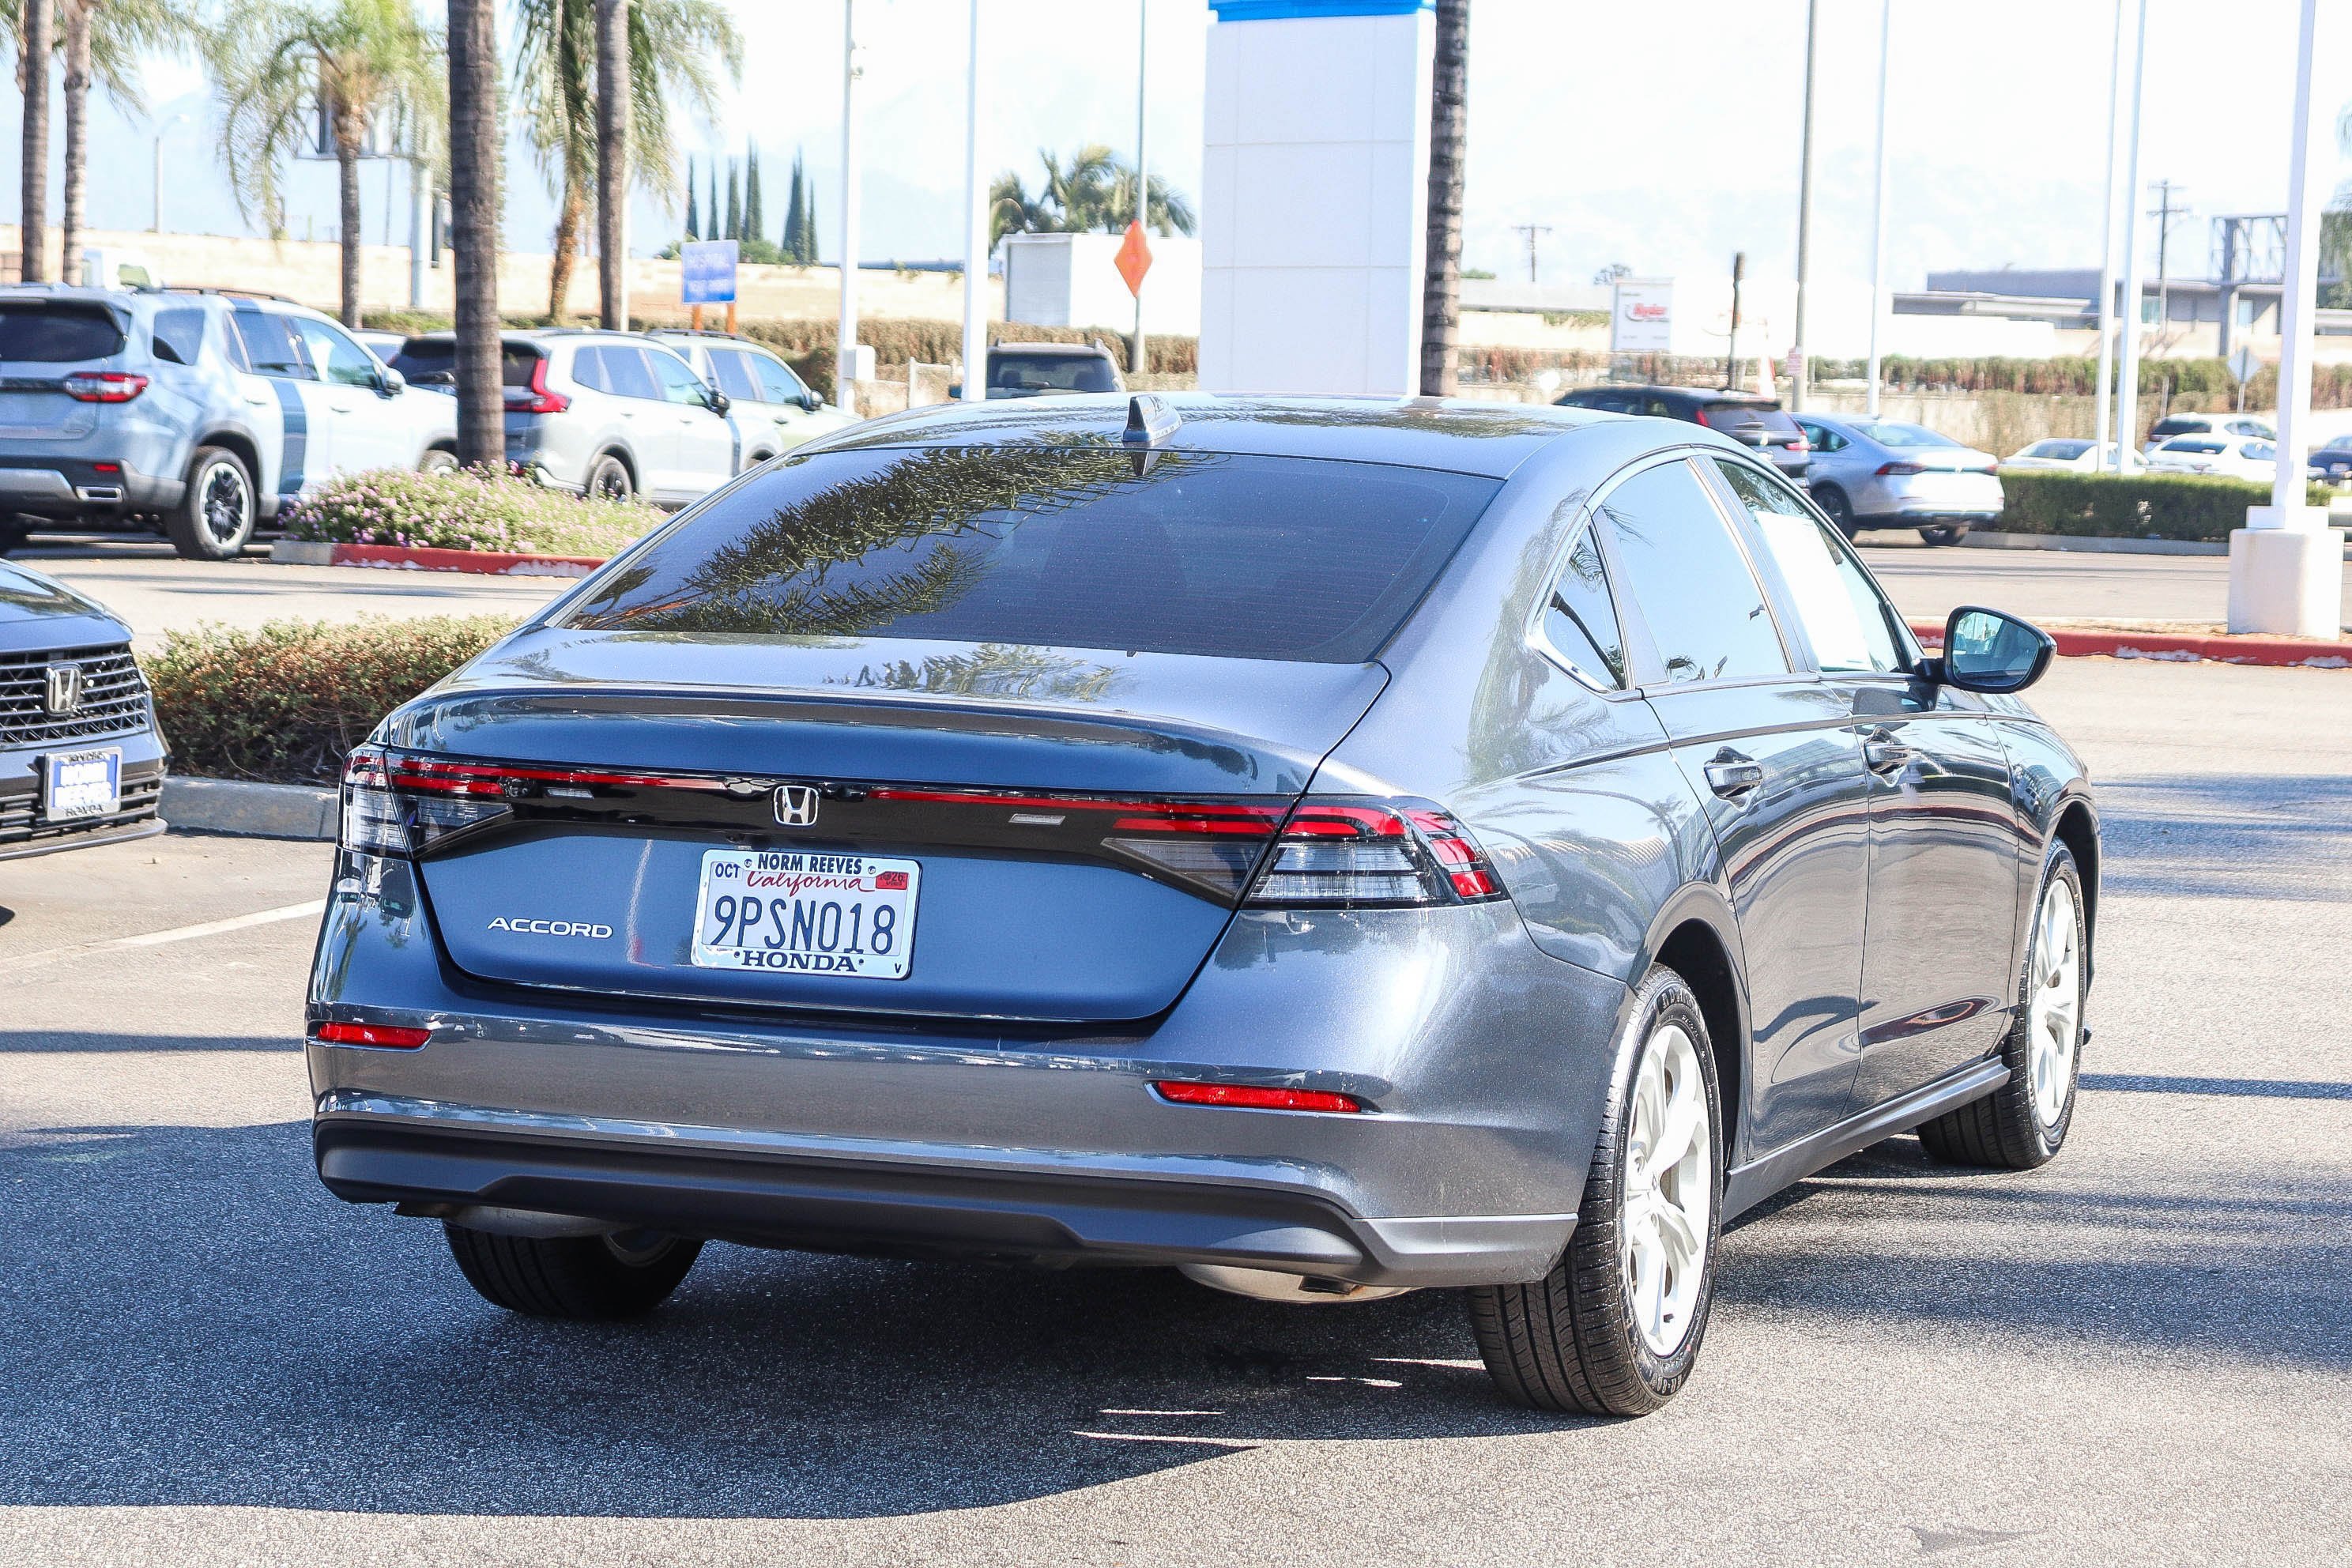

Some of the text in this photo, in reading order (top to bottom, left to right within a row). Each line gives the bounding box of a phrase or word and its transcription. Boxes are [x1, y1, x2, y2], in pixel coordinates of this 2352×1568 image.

[715, 862, 740, 878] OCT
[756, 853, 862, 875] NORM REEVES
[747, 870, 875, 897] California
[487, 916, 614, 939] ACCORD
[710, 895, 895, 955] 9PSN018
[741, 949, 858, 973] HONDA
